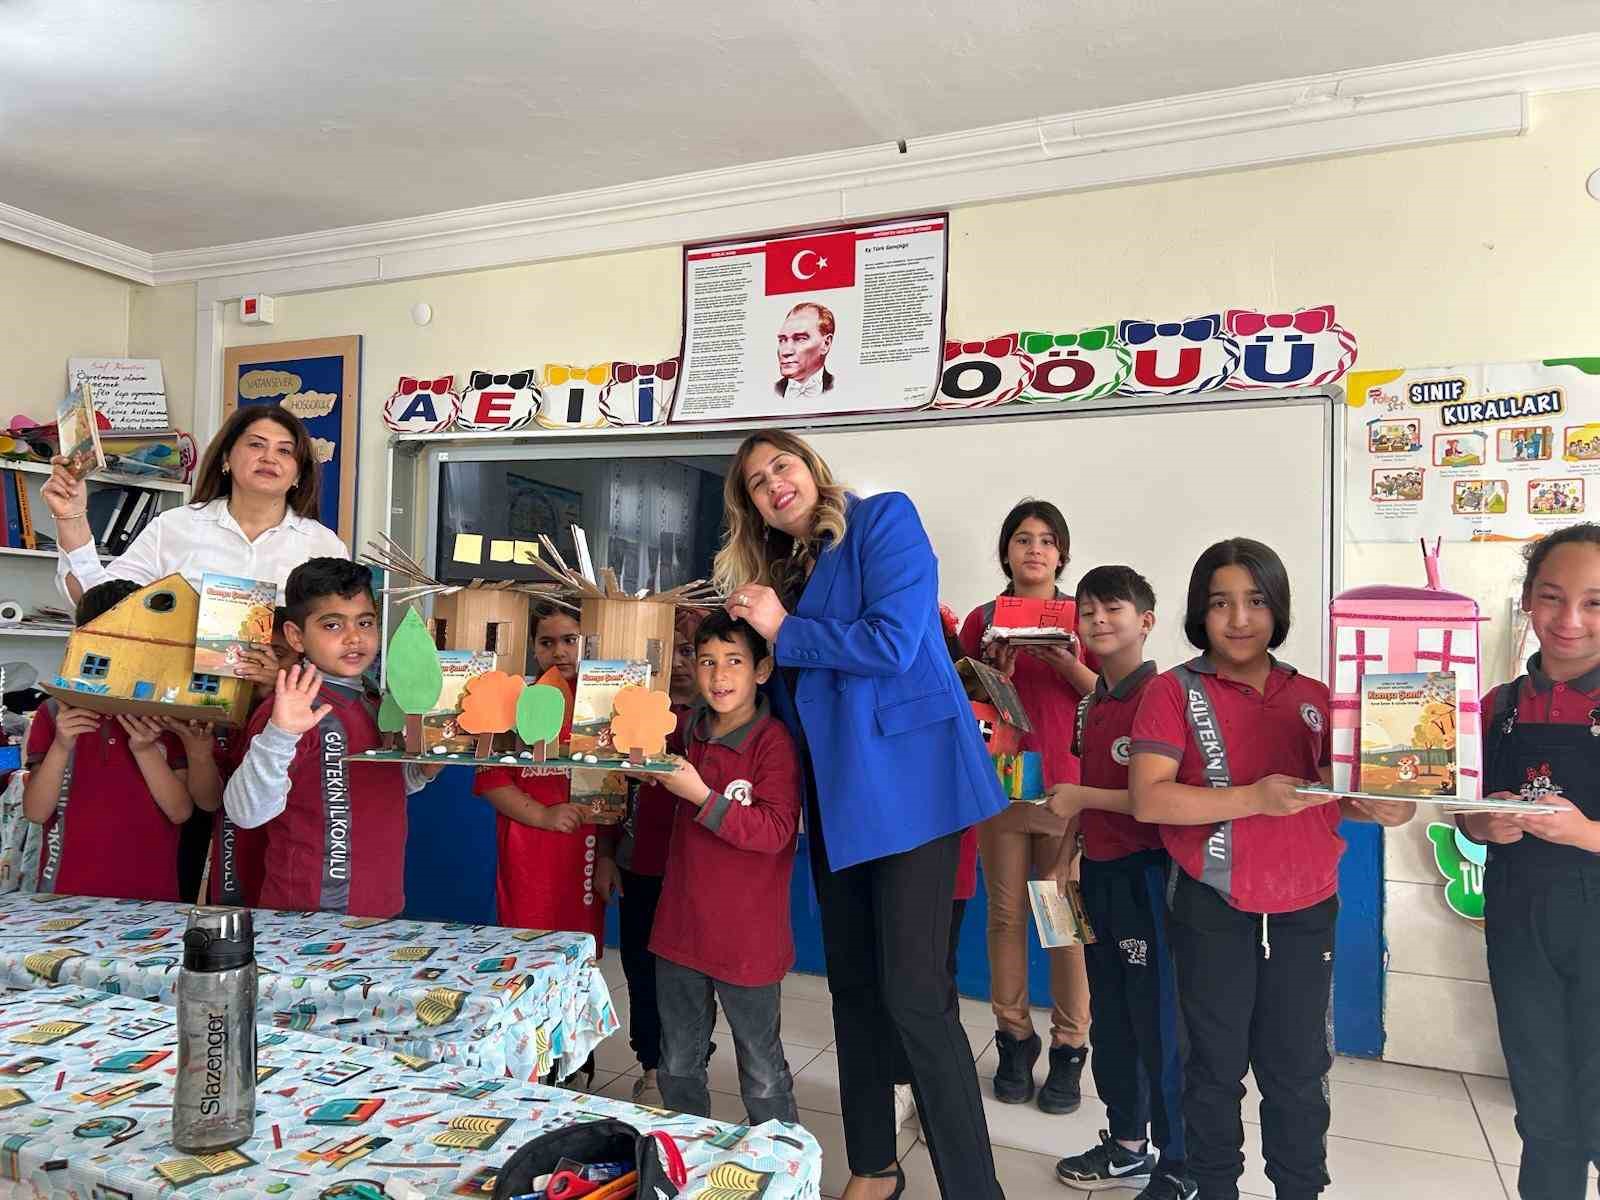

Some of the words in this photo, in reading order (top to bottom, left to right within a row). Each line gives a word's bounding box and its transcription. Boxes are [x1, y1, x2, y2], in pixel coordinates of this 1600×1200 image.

[1033, 350, 1095, 394] Ö
[1135, 347, 1203, 388] U
[1243, 335, 1315, 383] Ü
[1410, 380, 1465, 403] SINIF
[398, 394, 438, 422] A
[474, 392, 517, 424] E
[1442, 391, 1561, 427] KURALLARI
[1189, 688, 1224, 770] GÜLTEKİN
[324, 731, 347, 801] GÜLTEKİN
[329, 806, 349, 880] İLKOKULU
[200, 1013, 228, 1115] Slazenger
